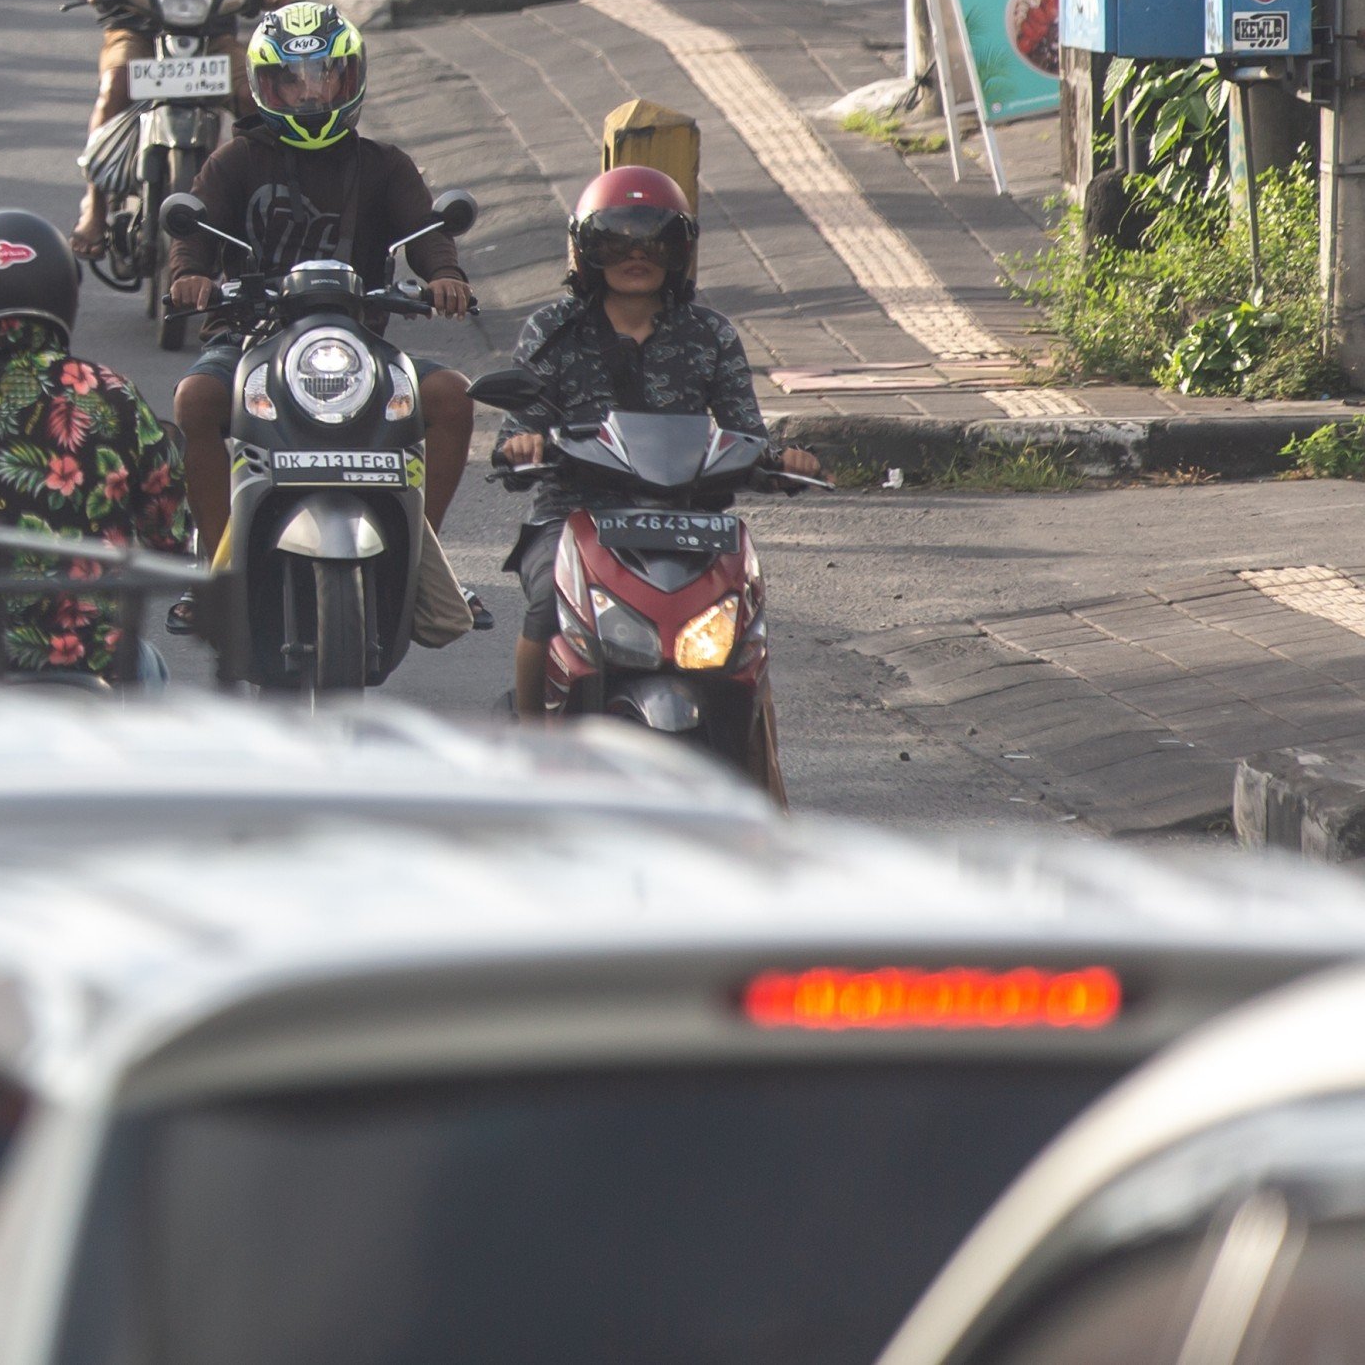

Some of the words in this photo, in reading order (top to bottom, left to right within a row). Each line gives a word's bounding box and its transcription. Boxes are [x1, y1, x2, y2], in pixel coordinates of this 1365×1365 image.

[133, 64, 154, 80] DK
[278, 454, 301, 469] DK
[309, 455, 356, 469] 2131
[601, 517, 629, 530] DK
[636, 515, 690, 531] 4643
